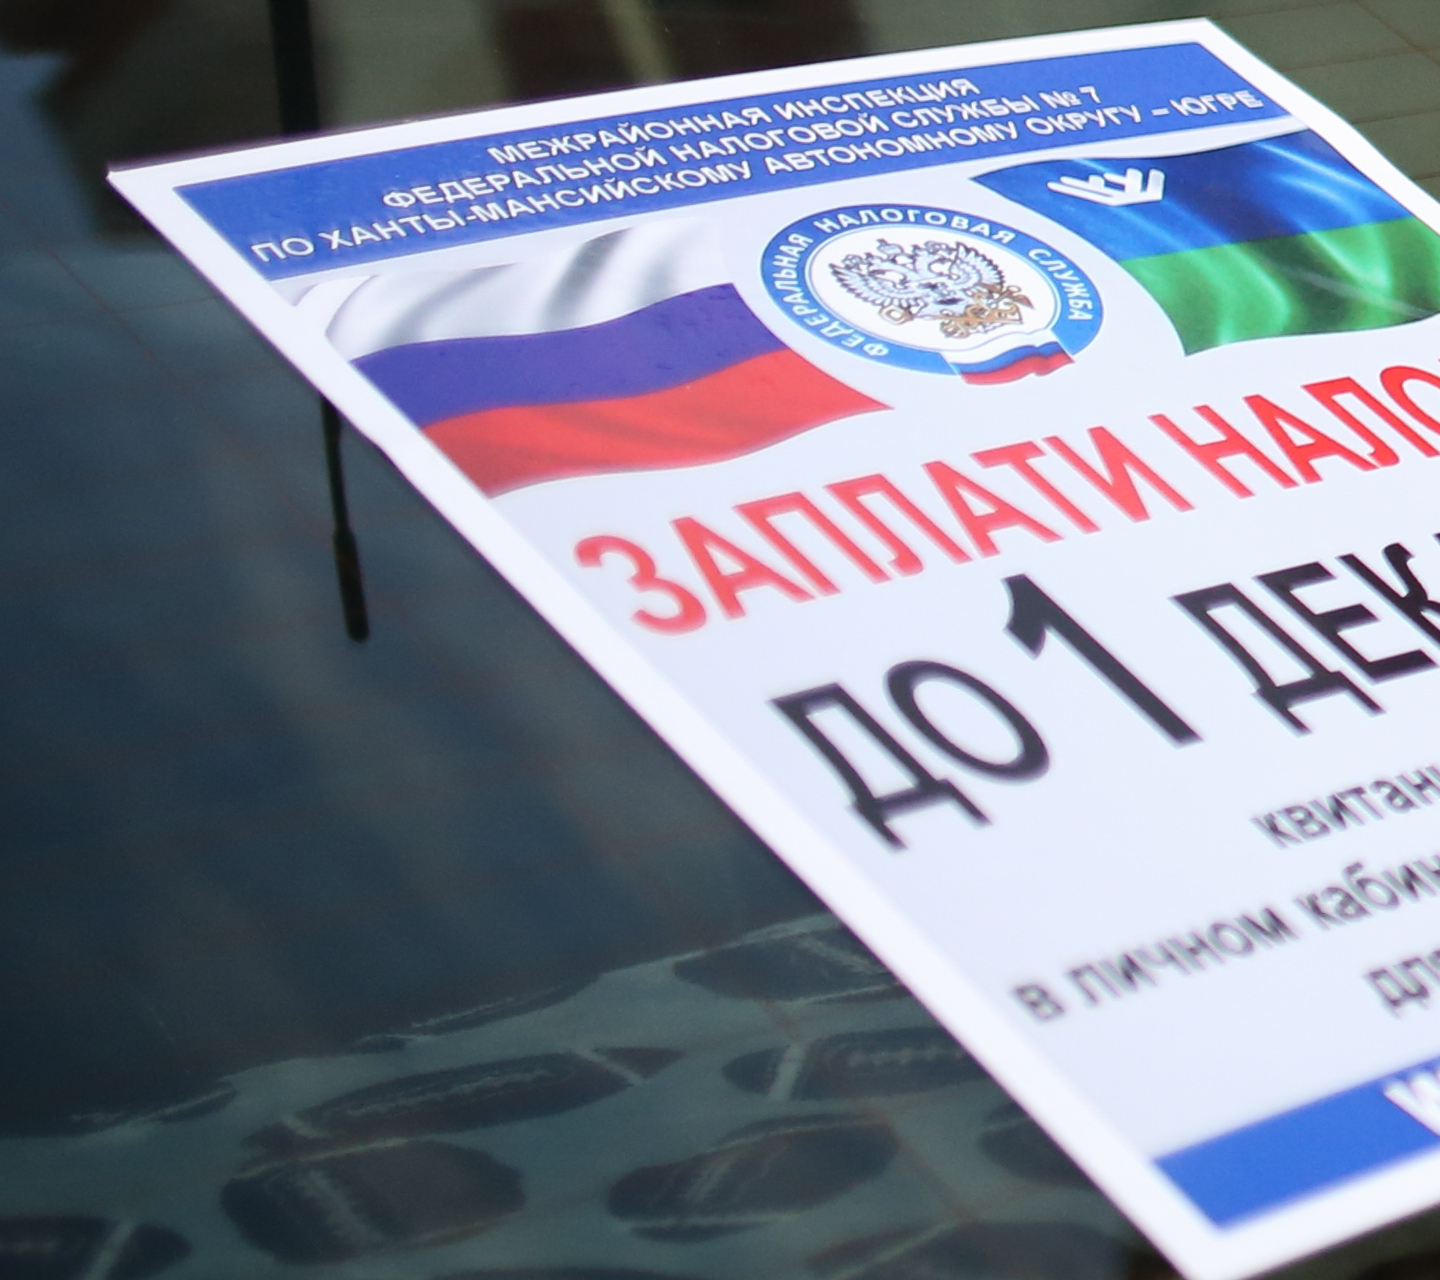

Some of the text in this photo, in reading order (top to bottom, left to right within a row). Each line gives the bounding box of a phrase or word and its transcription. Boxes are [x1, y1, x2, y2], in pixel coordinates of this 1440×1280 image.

[250, 237, 315, 263] ПО
[318, 161, 752, 250] ХАНТЫ-МАНСИЙСКОМУ
[765, 122, 1020, 176] АВТОНОМНОМУ
[1020, 104, 1143, 136] ОКРУГУ
[1171, 89, 1265, 118] ЮГРЕ
[382, 146, 666, 210] ФЕДЕРАЛЬНОЙ
[669, 112, 891, 160] НАЛОГОВОЙ
[890, 90, 1041, 129] СЛУЖБЫ
[1082, 85, 1101, 105] 7
[487, 77, 981, 165] МЕЖРАЙОННАЯ ИНСПЕКЦИЯ
[773, 208, 1093, 357] ФЕДЕРАЛЬНАЯ НАЛОГОВАЯ СЛУЖБА
[572, 424, 1195, 636] ЗАПЛАТИ
[770, 658, 1050, 852] ДО
[1001, 573, 1202, 747] 1
[1012, 977, 1065, 1023] в
[1065, 902, 1300, 1010] личном
